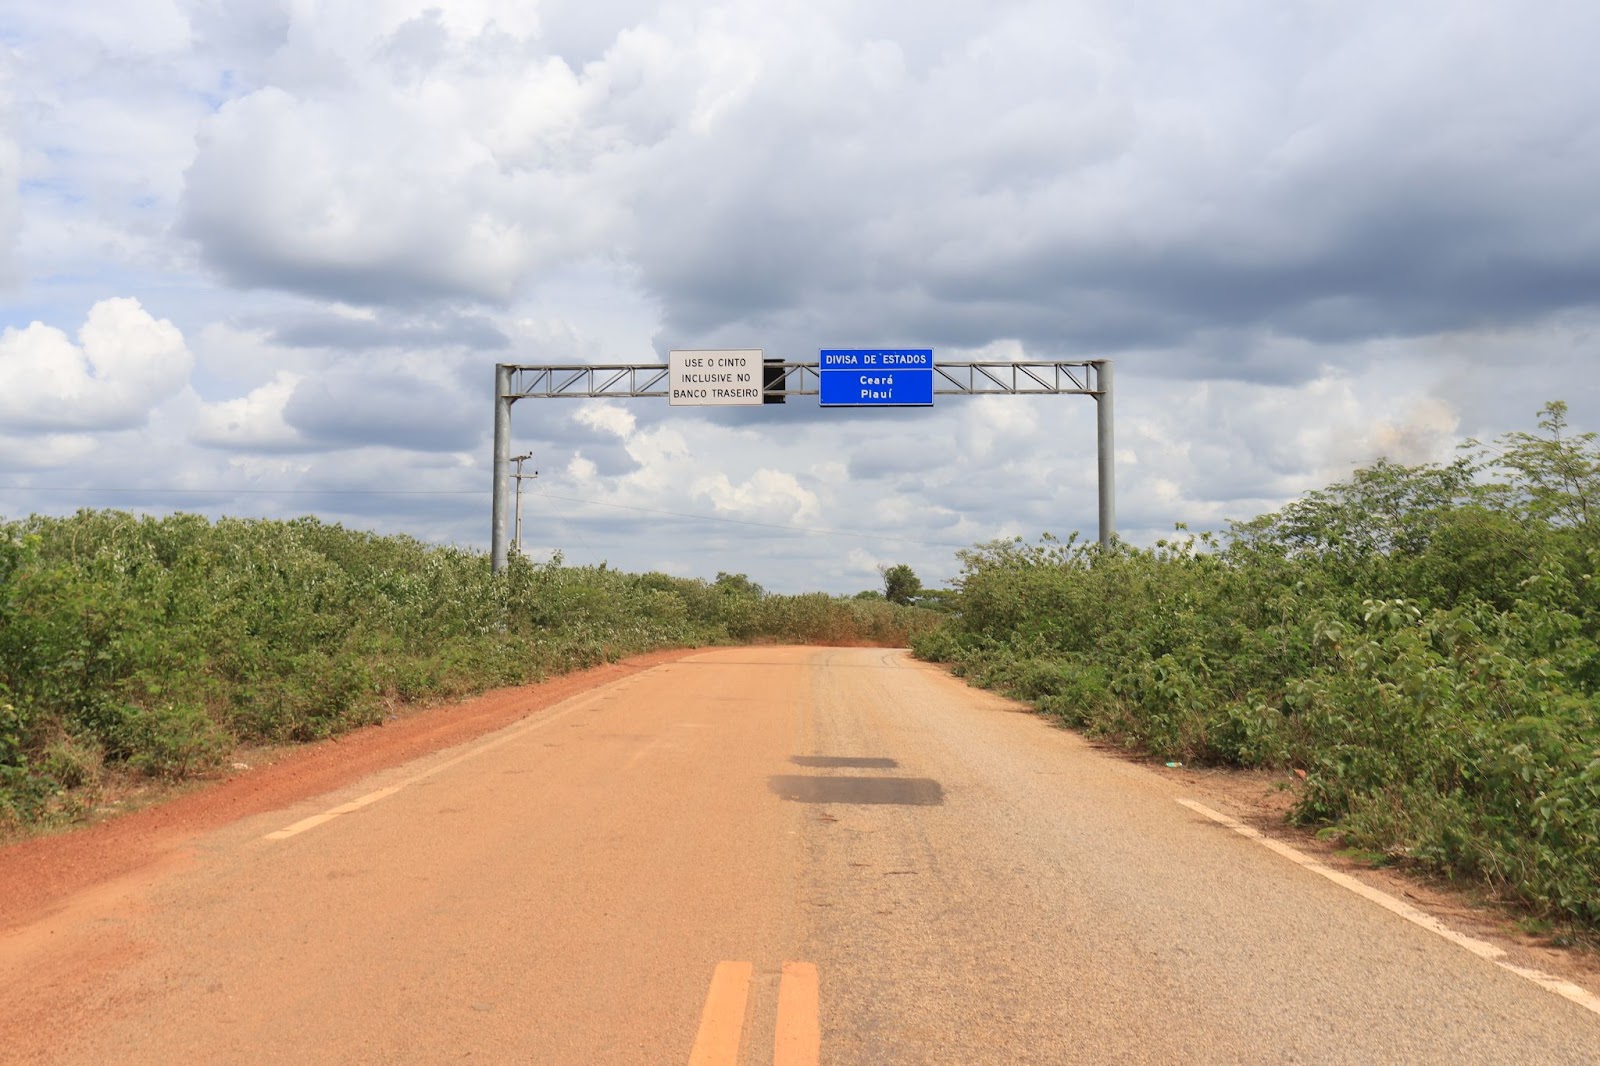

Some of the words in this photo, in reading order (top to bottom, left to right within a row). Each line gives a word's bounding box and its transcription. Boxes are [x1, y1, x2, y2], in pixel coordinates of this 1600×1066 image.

[684, 358, 704, 368] USE
[707, 358, 714, 367] O
[717, 358, 747, 367] CINTO
[825, 354, 858, 364] DIVISA
[863, 354, 877, 364] DE
[882, 354, 927, 364] ESTADOS
[681, 373, 733, 383] INCLUSIVE
[737, 373, 751, 382] NO
[859, 374, 893, 385] Ceará
[673, 389, 707, 398] BANCO
[712, 388, 759, 398] TRASEIRO
[861, 388, 893, 399] Piauí
